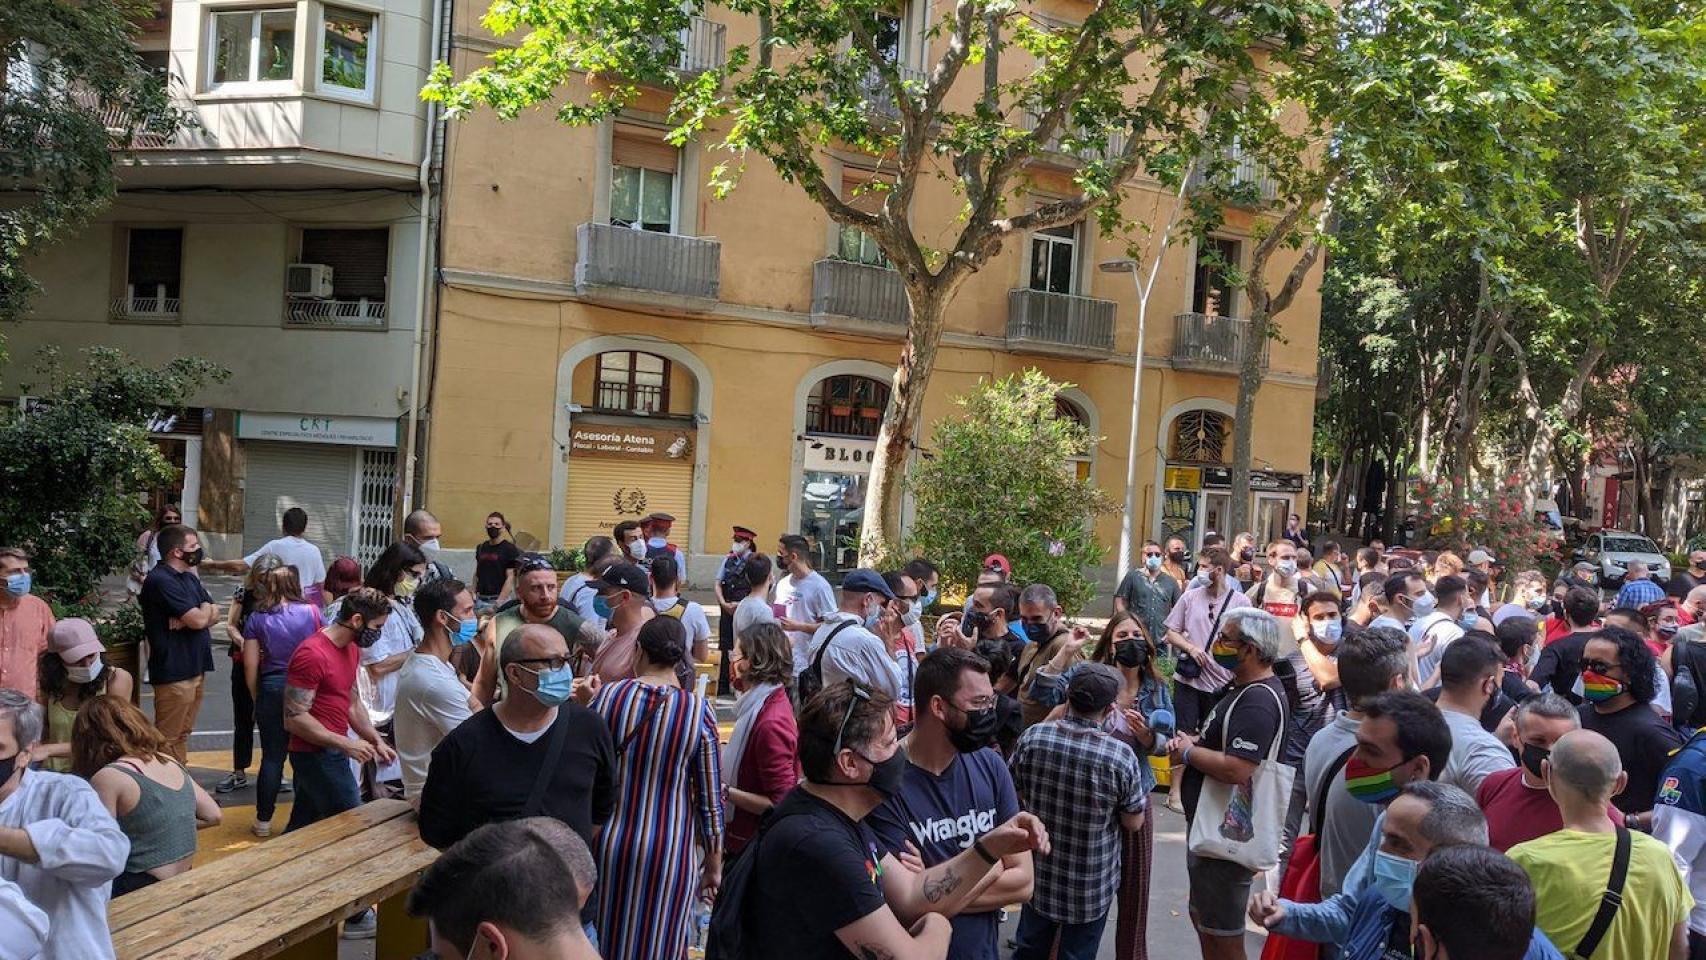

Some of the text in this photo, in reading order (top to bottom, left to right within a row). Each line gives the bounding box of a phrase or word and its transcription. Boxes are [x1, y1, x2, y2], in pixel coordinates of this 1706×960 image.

[300, 416, 333, 432] CRT
[575, 430, 656, 445] Asesoría Atena
[909, 807, 997, 849] Wrangler
